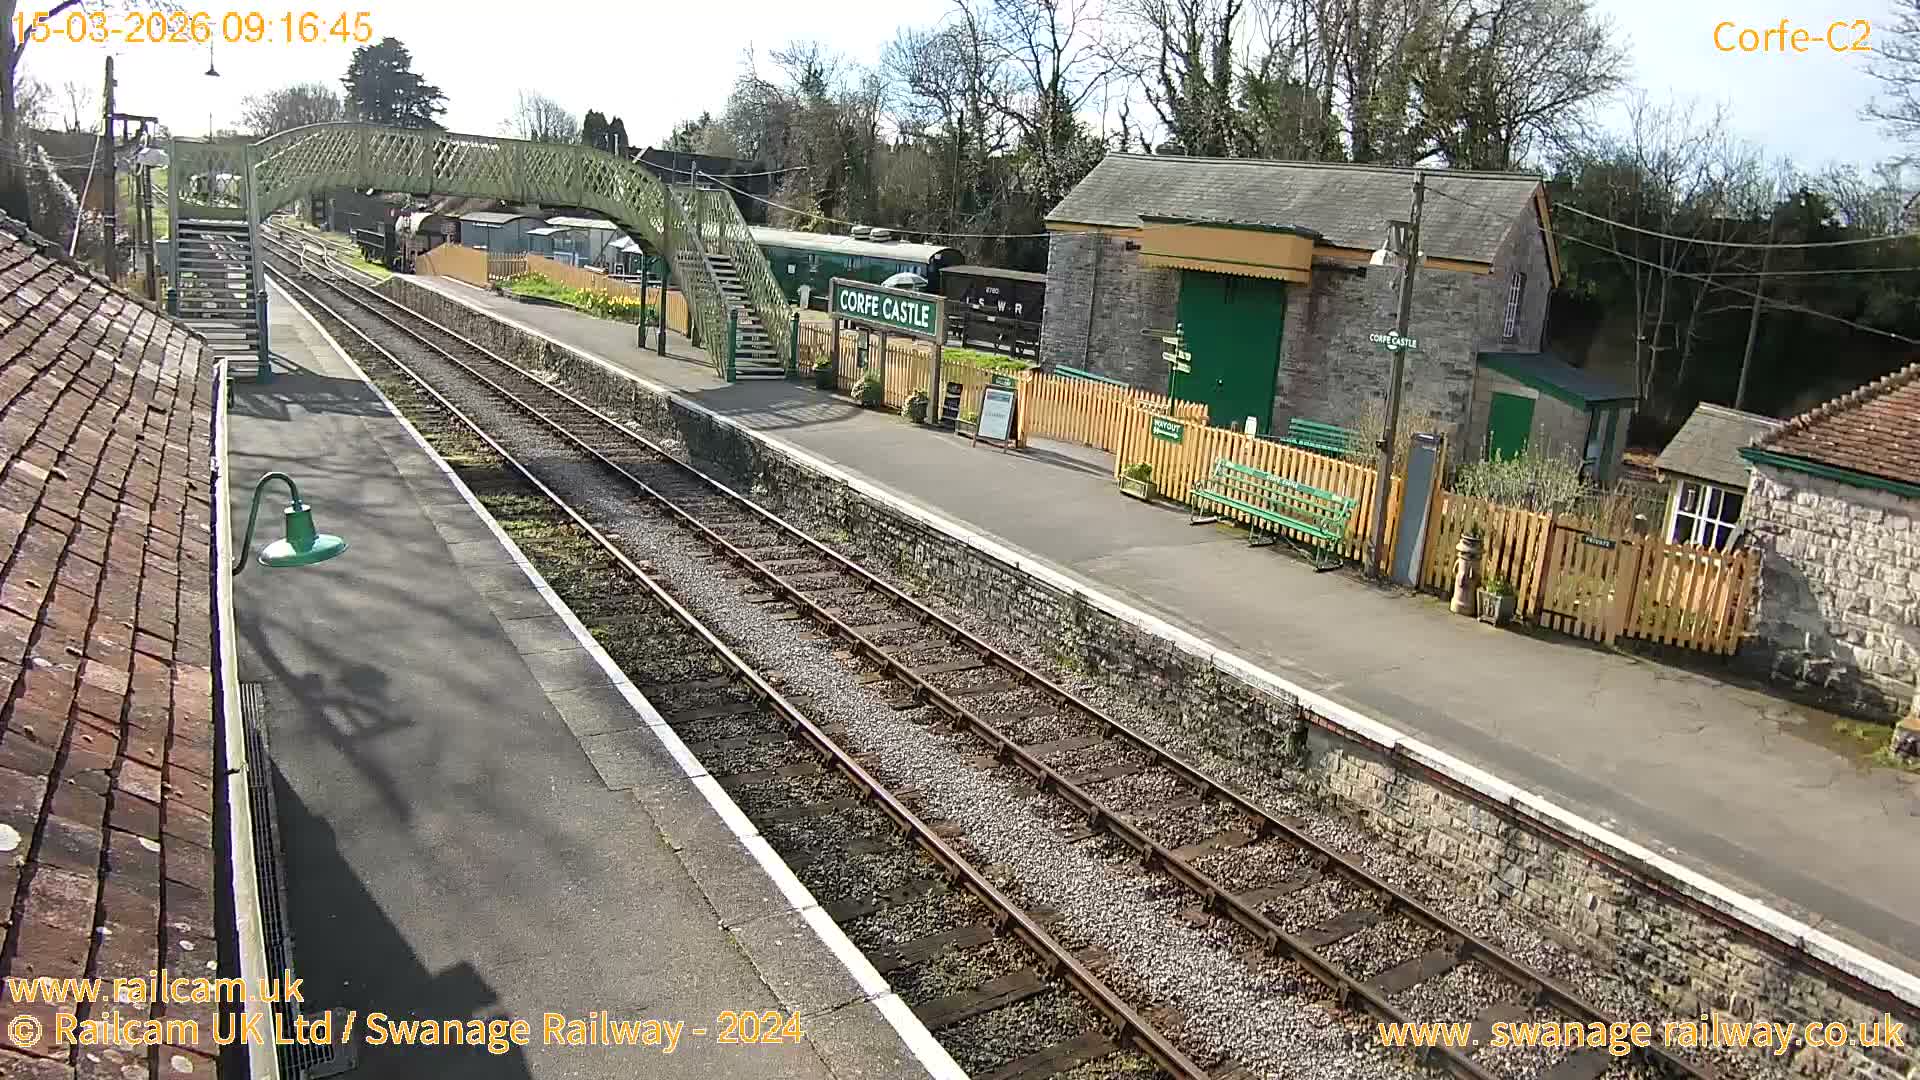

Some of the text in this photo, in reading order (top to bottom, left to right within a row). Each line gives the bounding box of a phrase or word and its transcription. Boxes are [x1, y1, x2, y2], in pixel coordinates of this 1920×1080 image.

[840, 289, 930, 328] CORFE CASTLE
[1369, 333, 1417, 349] CORFE CASTLE
